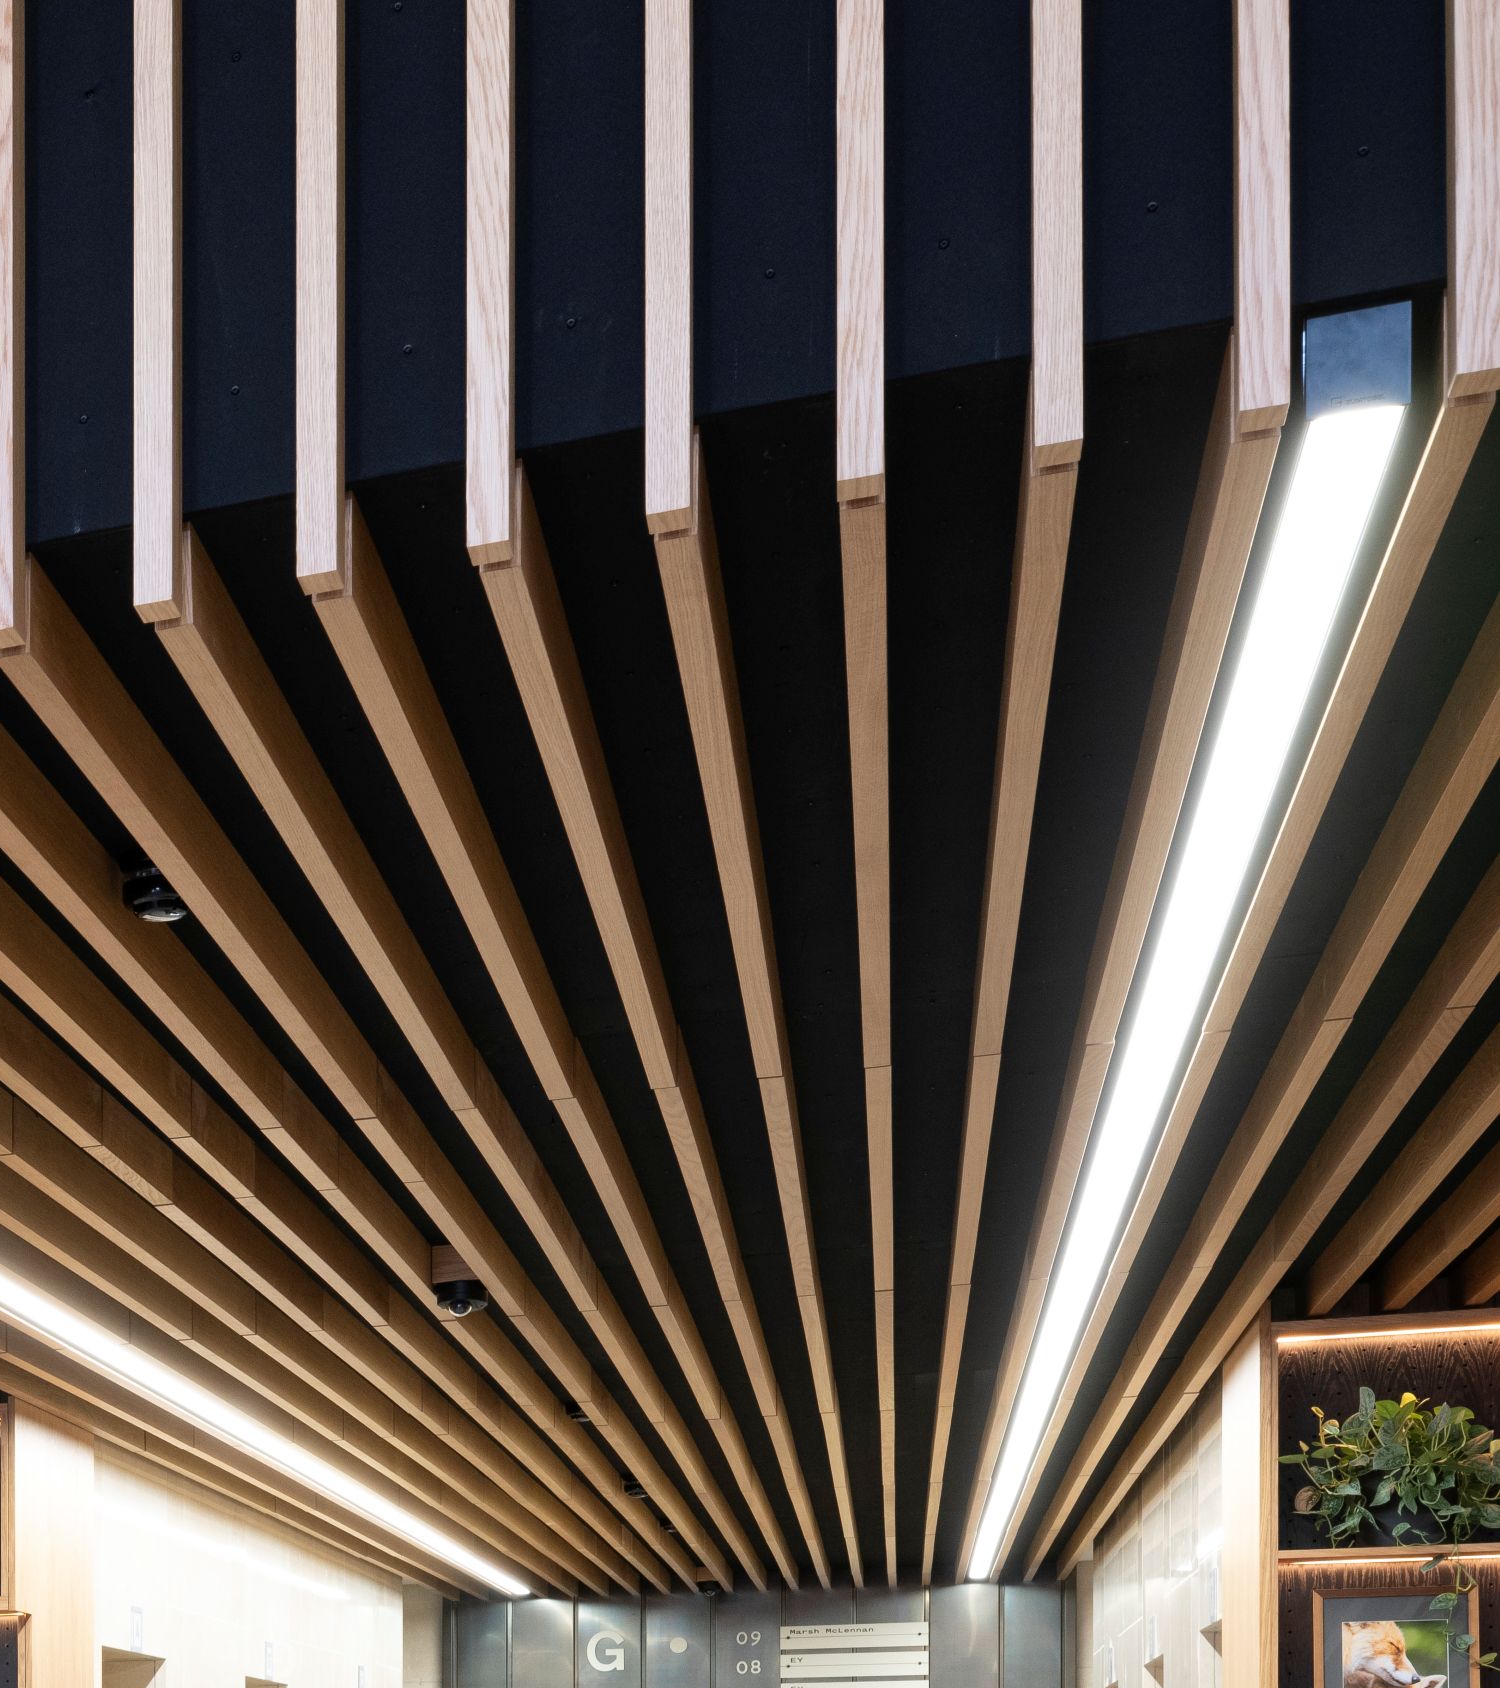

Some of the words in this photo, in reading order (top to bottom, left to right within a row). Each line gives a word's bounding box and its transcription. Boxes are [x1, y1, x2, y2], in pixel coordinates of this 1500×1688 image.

[825, 1626, 874, 1634] McLennan
[736, 1631, 762, 1646] 09
[586, 1630, 625, 1672] G
[736, 1660, 762, 1675] 08
